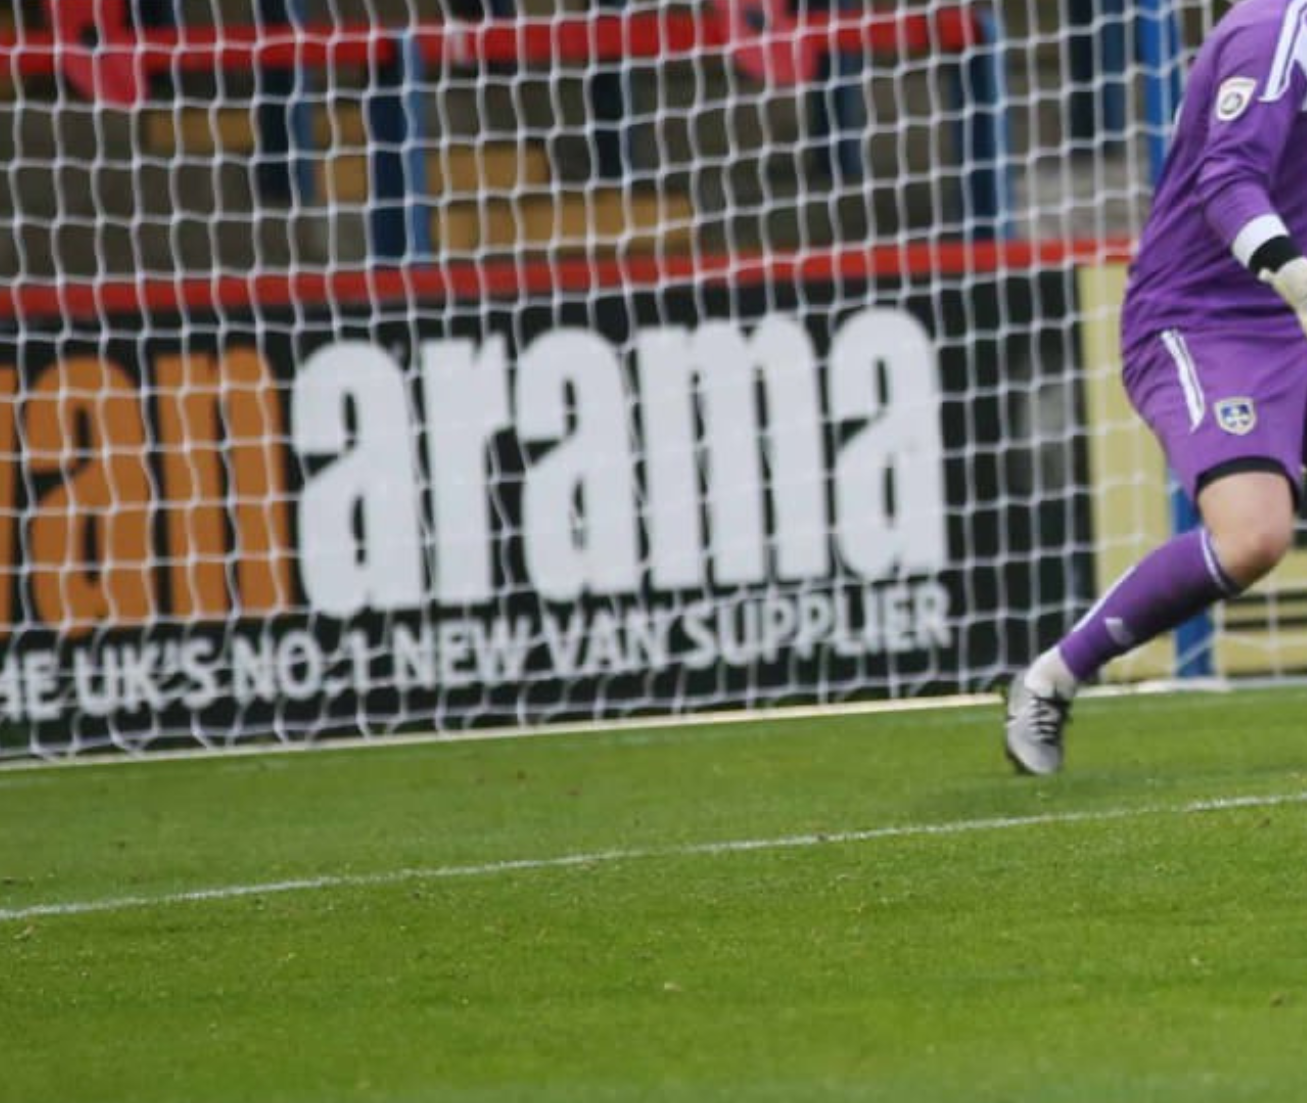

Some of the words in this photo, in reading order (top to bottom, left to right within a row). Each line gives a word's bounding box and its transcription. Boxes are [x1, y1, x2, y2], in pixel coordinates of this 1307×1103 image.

[0, 305, 951, 639] anarama
[392, 615, 532, 691] NEW
[543, 603, 670, 676] VAN
[682, 579, 951, 669] SUPPLIER
